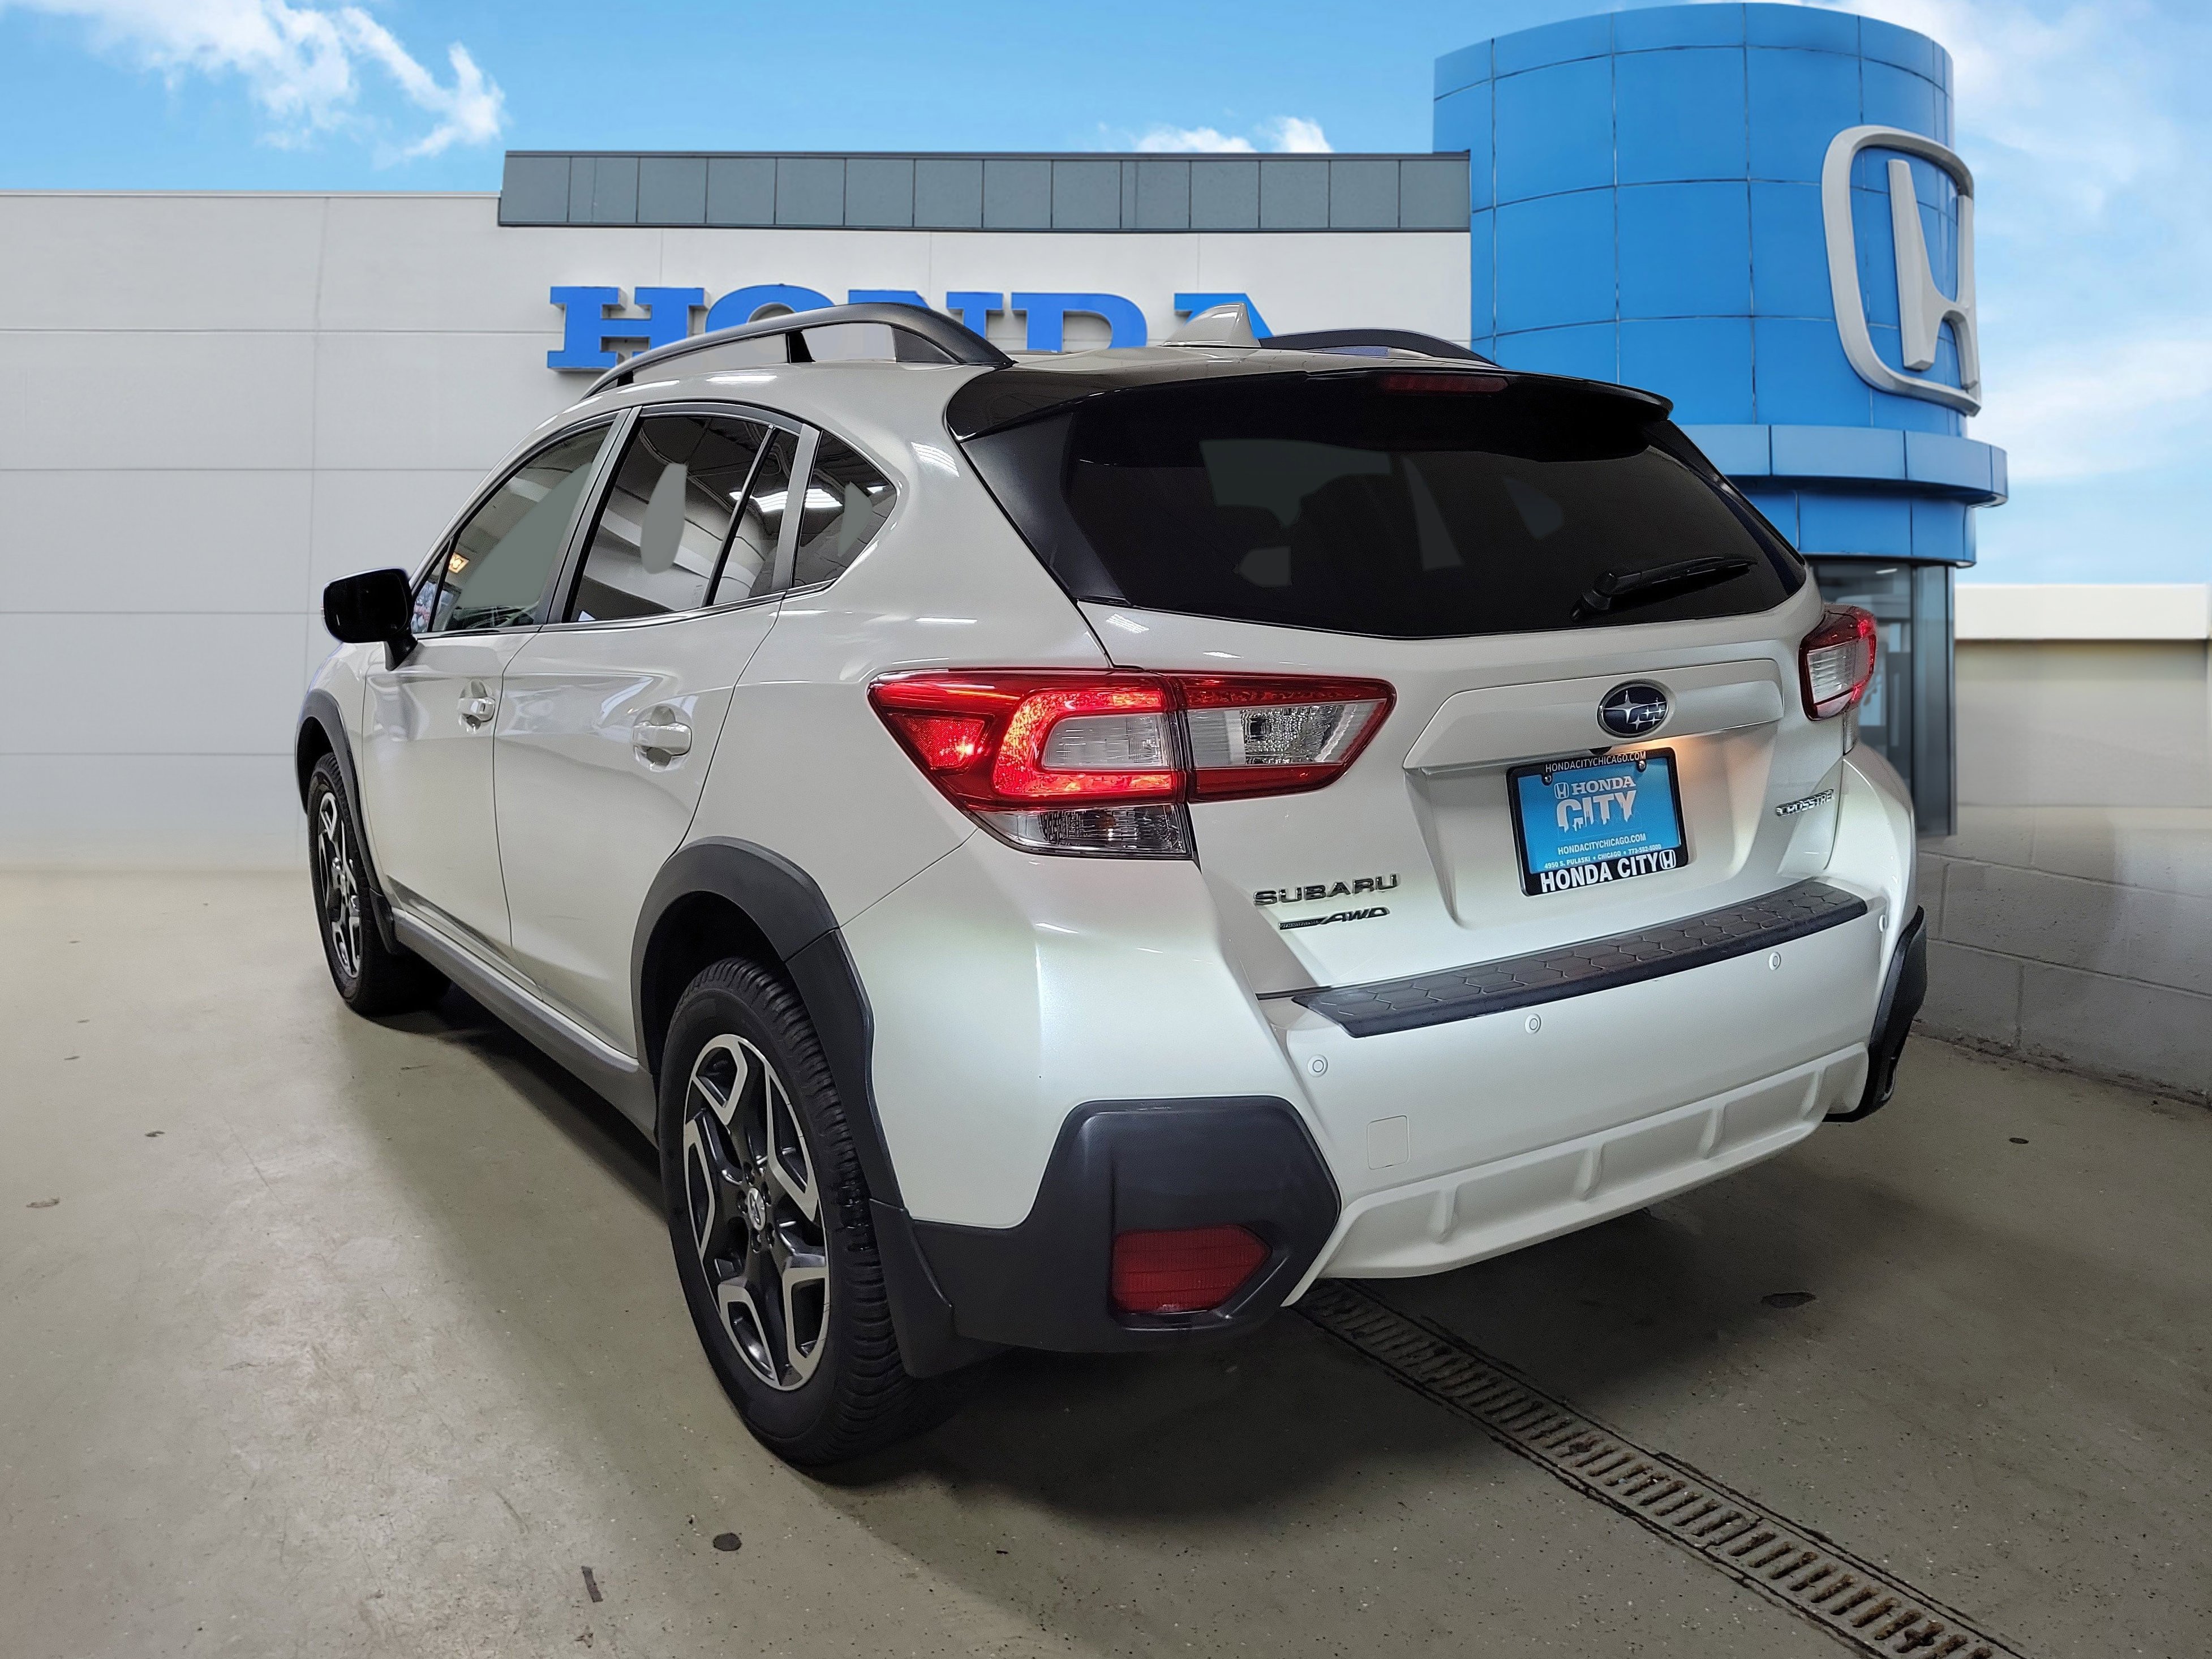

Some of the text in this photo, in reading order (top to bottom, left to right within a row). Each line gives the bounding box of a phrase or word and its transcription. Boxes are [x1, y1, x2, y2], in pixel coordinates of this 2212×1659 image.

[1545, 751, 1646, 773] HONDACITYCHICAGO.COM
[1571, 776, 1636, 795] HONDA
[1557, 790, 1637, 833] CITY
[1557, 833, 1646, 855] HONDACITYCHICAGO.COM
[1566, 856, 1591, 866] PULASKI
[1597, 851, 1621, 860] CHICAGO
[1540, 861, 1613, 892] HONDA
[1617, 852, 1658, 878] CITY
[1253, 874, 1399, 905] SUBARU
[1320, 906, 1390, 925] AWD
